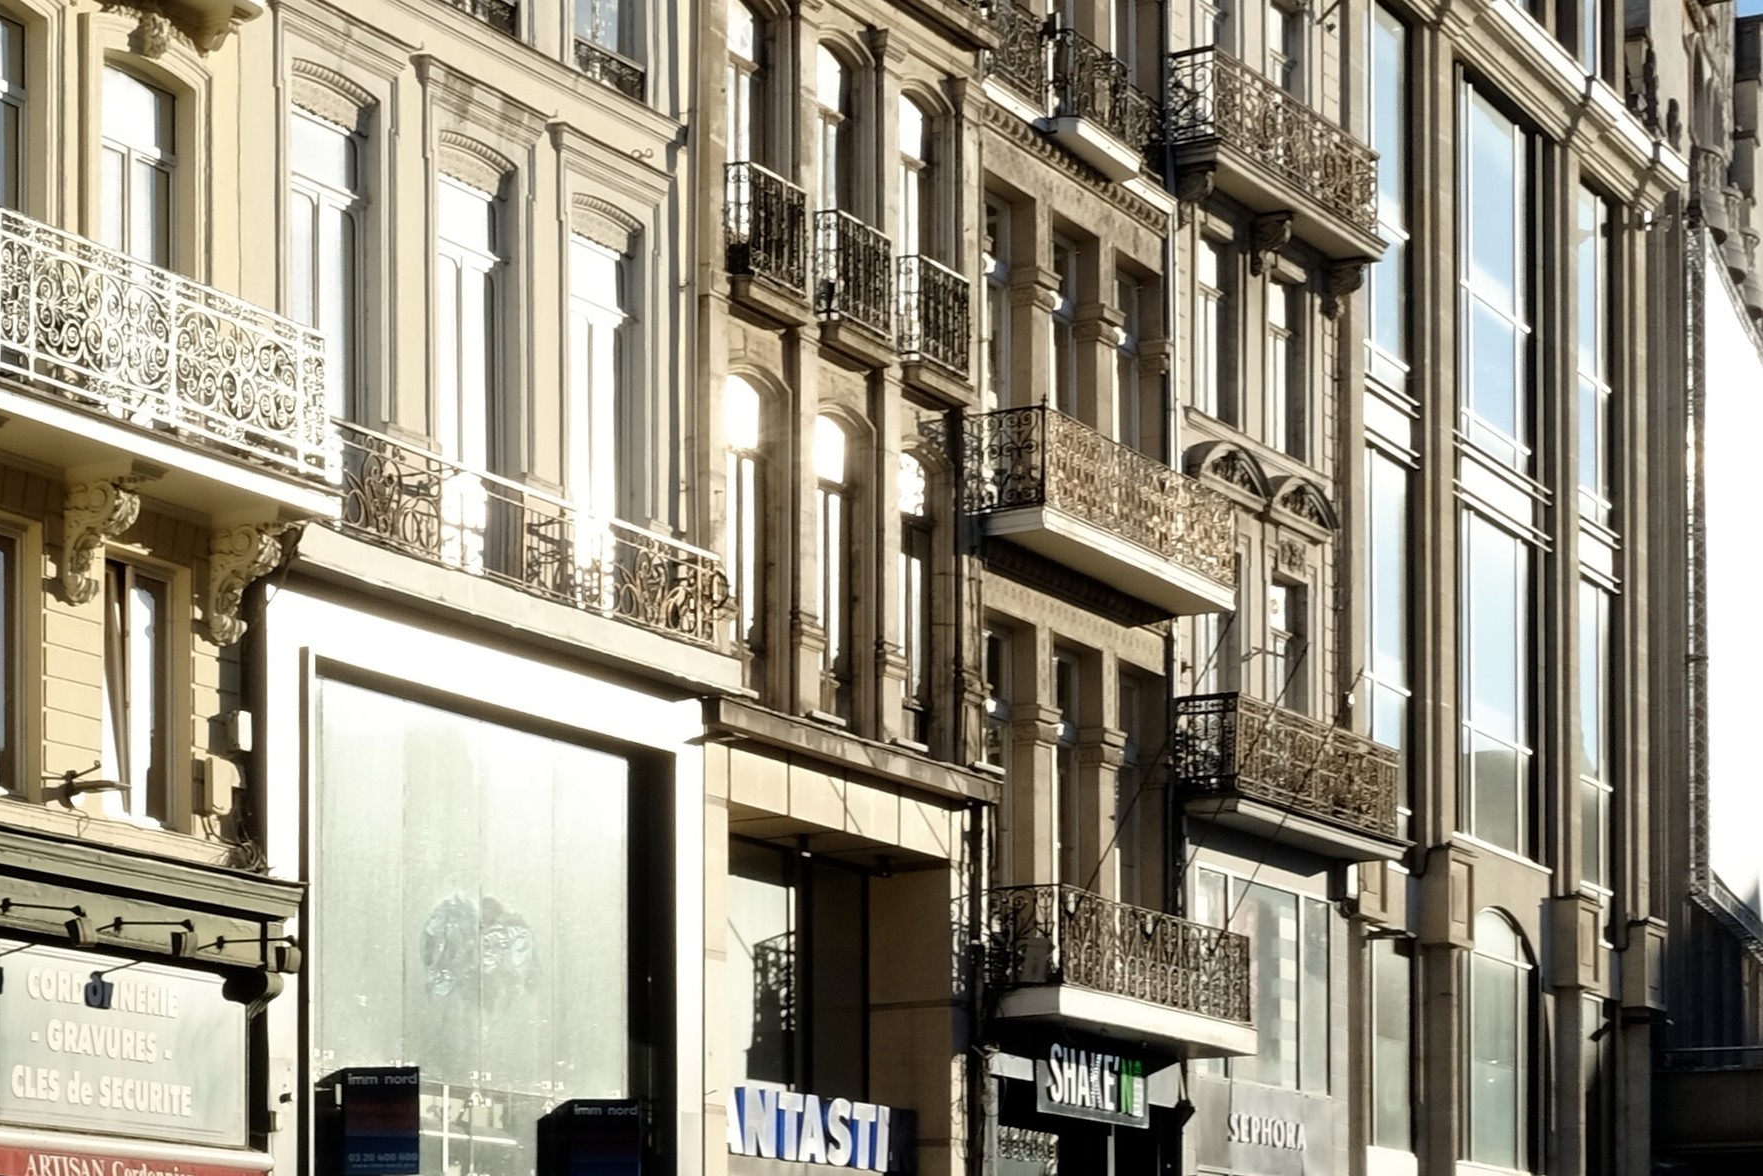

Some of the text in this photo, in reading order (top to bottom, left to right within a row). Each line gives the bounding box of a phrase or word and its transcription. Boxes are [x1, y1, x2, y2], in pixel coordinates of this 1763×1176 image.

[27, 966, 179, 1018] CORDONNERIE
[47, 1018, 157, 1063] GRAVURES
[11, 1064, 192, 1116] CLES de SECURITE
[1227, 1112, 1307, 1151] SEPHORA
